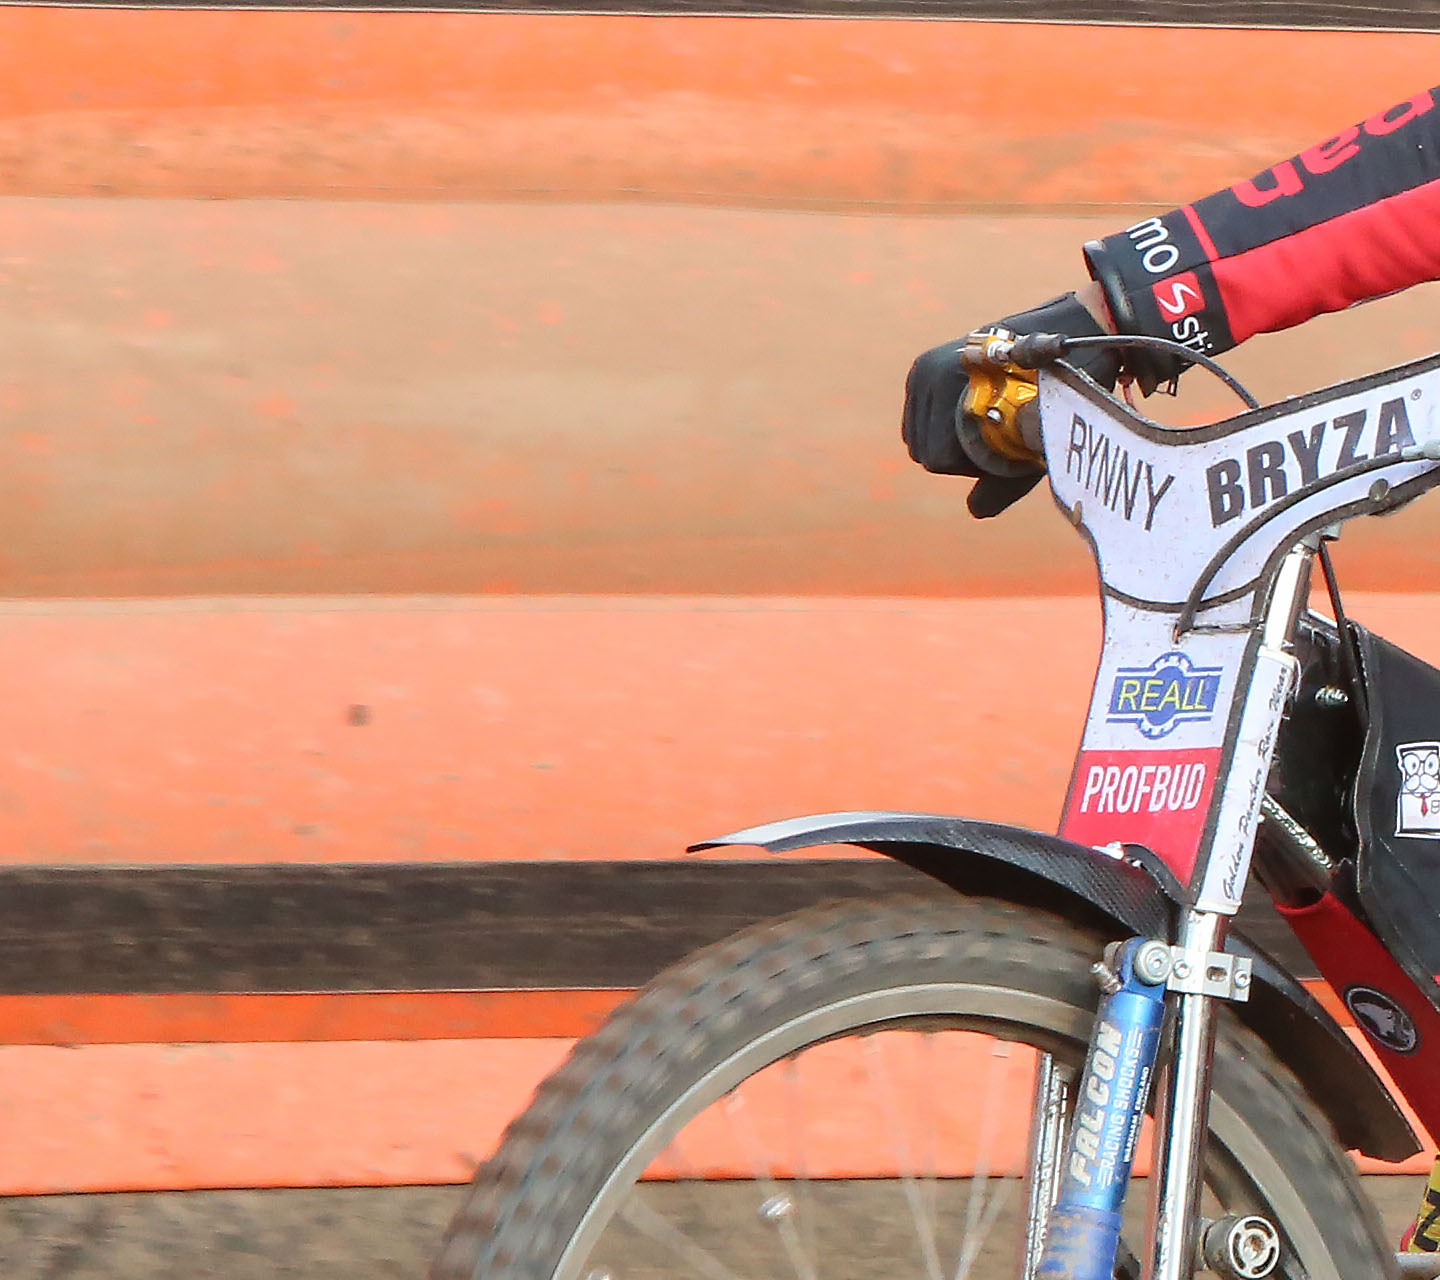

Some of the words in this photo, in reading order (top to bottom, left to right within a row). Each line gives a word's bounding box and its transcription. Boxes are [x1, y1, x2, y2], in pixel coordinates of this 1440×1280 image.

[1065, 412, 1176, 532] RYNNY
[1204, 399, 1421, 529] BRYZA
[1116, 678, 1212, 714] REALL
[1080, 761, 1206, 814] PROFBUD
[1070, 1020, 1123, 1187] FALCON
[1113, 1047, 1141, 1113] SHOCKS
[1101, 1113, 1127, 1171] RACING
